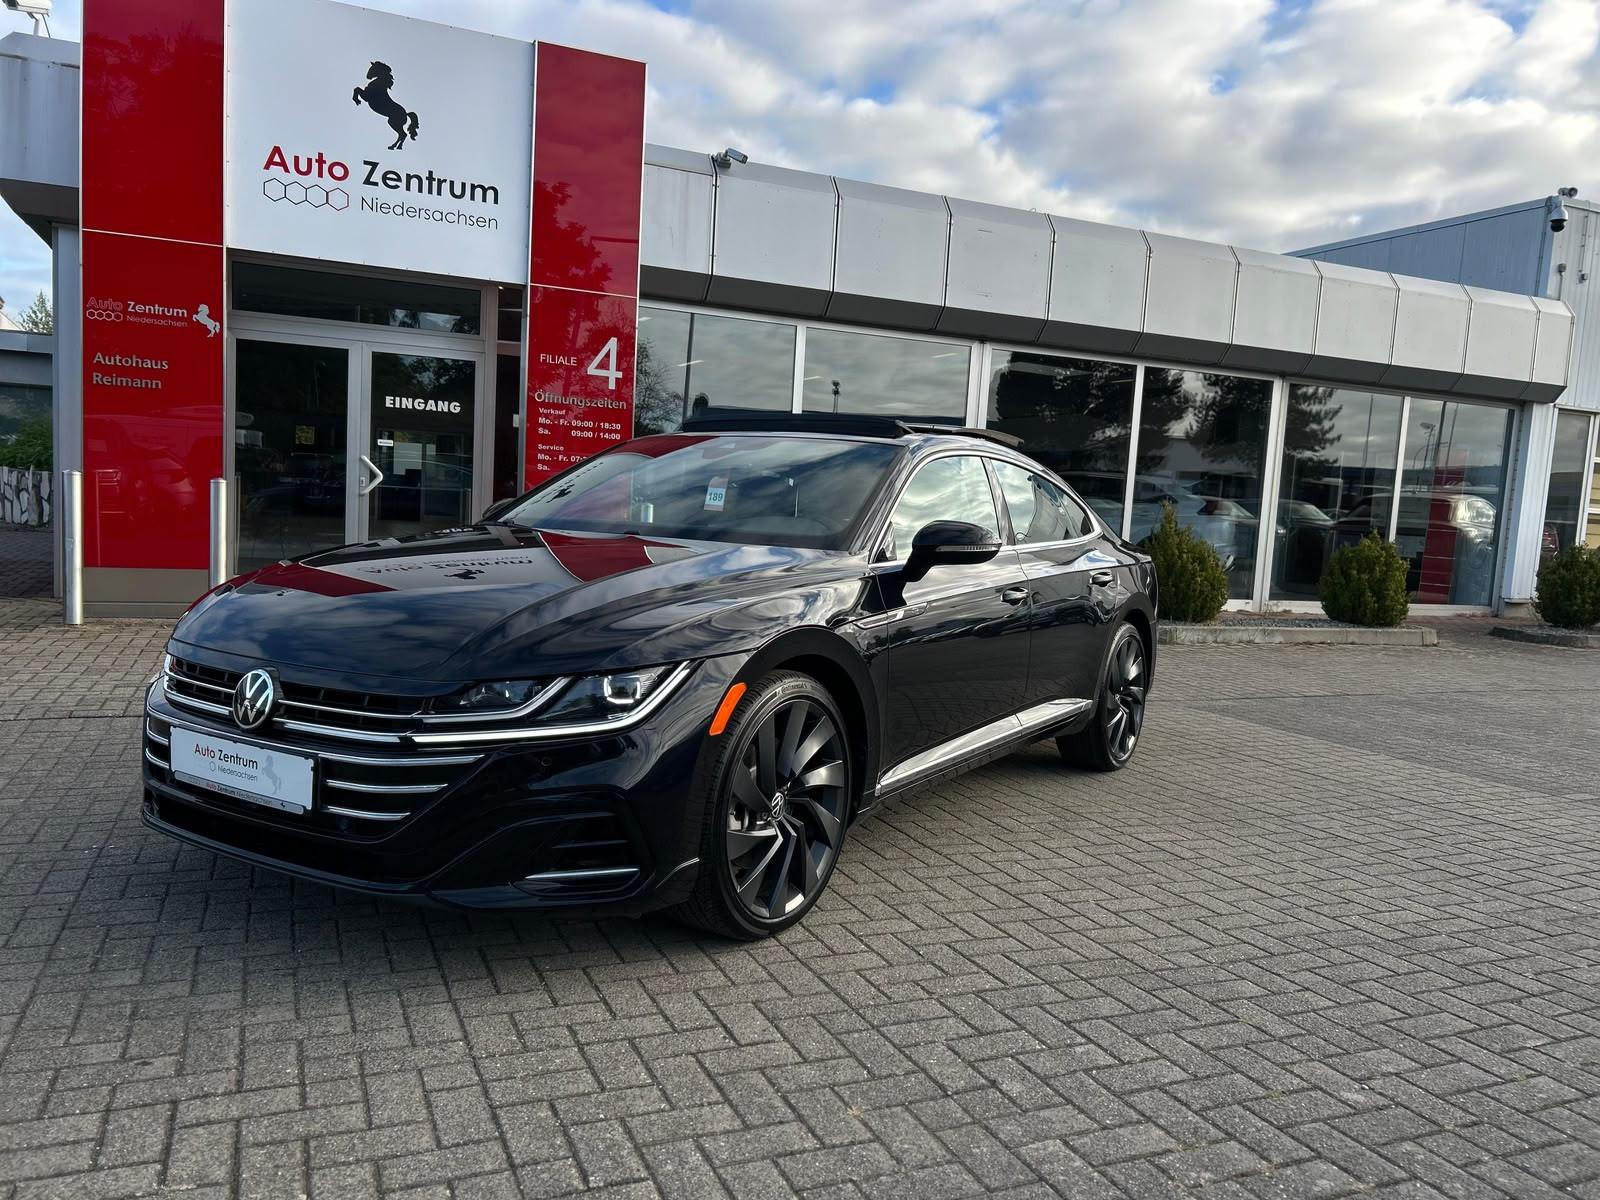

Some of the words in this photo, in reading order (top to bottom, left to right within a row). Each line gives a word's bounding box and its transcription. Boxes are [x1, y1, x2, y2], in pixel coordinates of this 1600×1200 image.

[263, 145, 350, 182] Auto
[362, 159, 499, 205] Zentrum
[360, 196, 499, 231] Niedersachsen
[86, 296, 124, 311] Auto
[127, 301, 188, 318] Zentrum
[126, 314, 188, 328] Niedersachsen
[93, 352, 169, 370] Autohaus
[540, 354, 577, 365] FILIALE
[586, 336, 623, 390] 4
[92, 372, 162, 389] Reimann
[385, 395, 462, 414] EINGANG
[535, 389, 627, 409] Öffnungszeiten
[538, 407, 566, 415] Verkauf
[538, 417, 553, 425] Mo.
[571, 420, 594, 428] 09:00
[600, 422, 621, 430] 18:30
[538, 427, 551, 435] Sa.
[571, 430, 593, 438] 09:00
[600, 432, 621, 440] 14:00
[537, 443, 565, 451] Service
[537, 453, 552, 461] Mo.
[558, 454, 569, 462] Fr.
[537, 463, 551, 471] Sa.
[708, 491, 724, 502] 189
[194, 743, 216, 759] Auto
[218, 749, 258, 770] Zentrum
[218, 765, 258, 781] Niedersachsen
